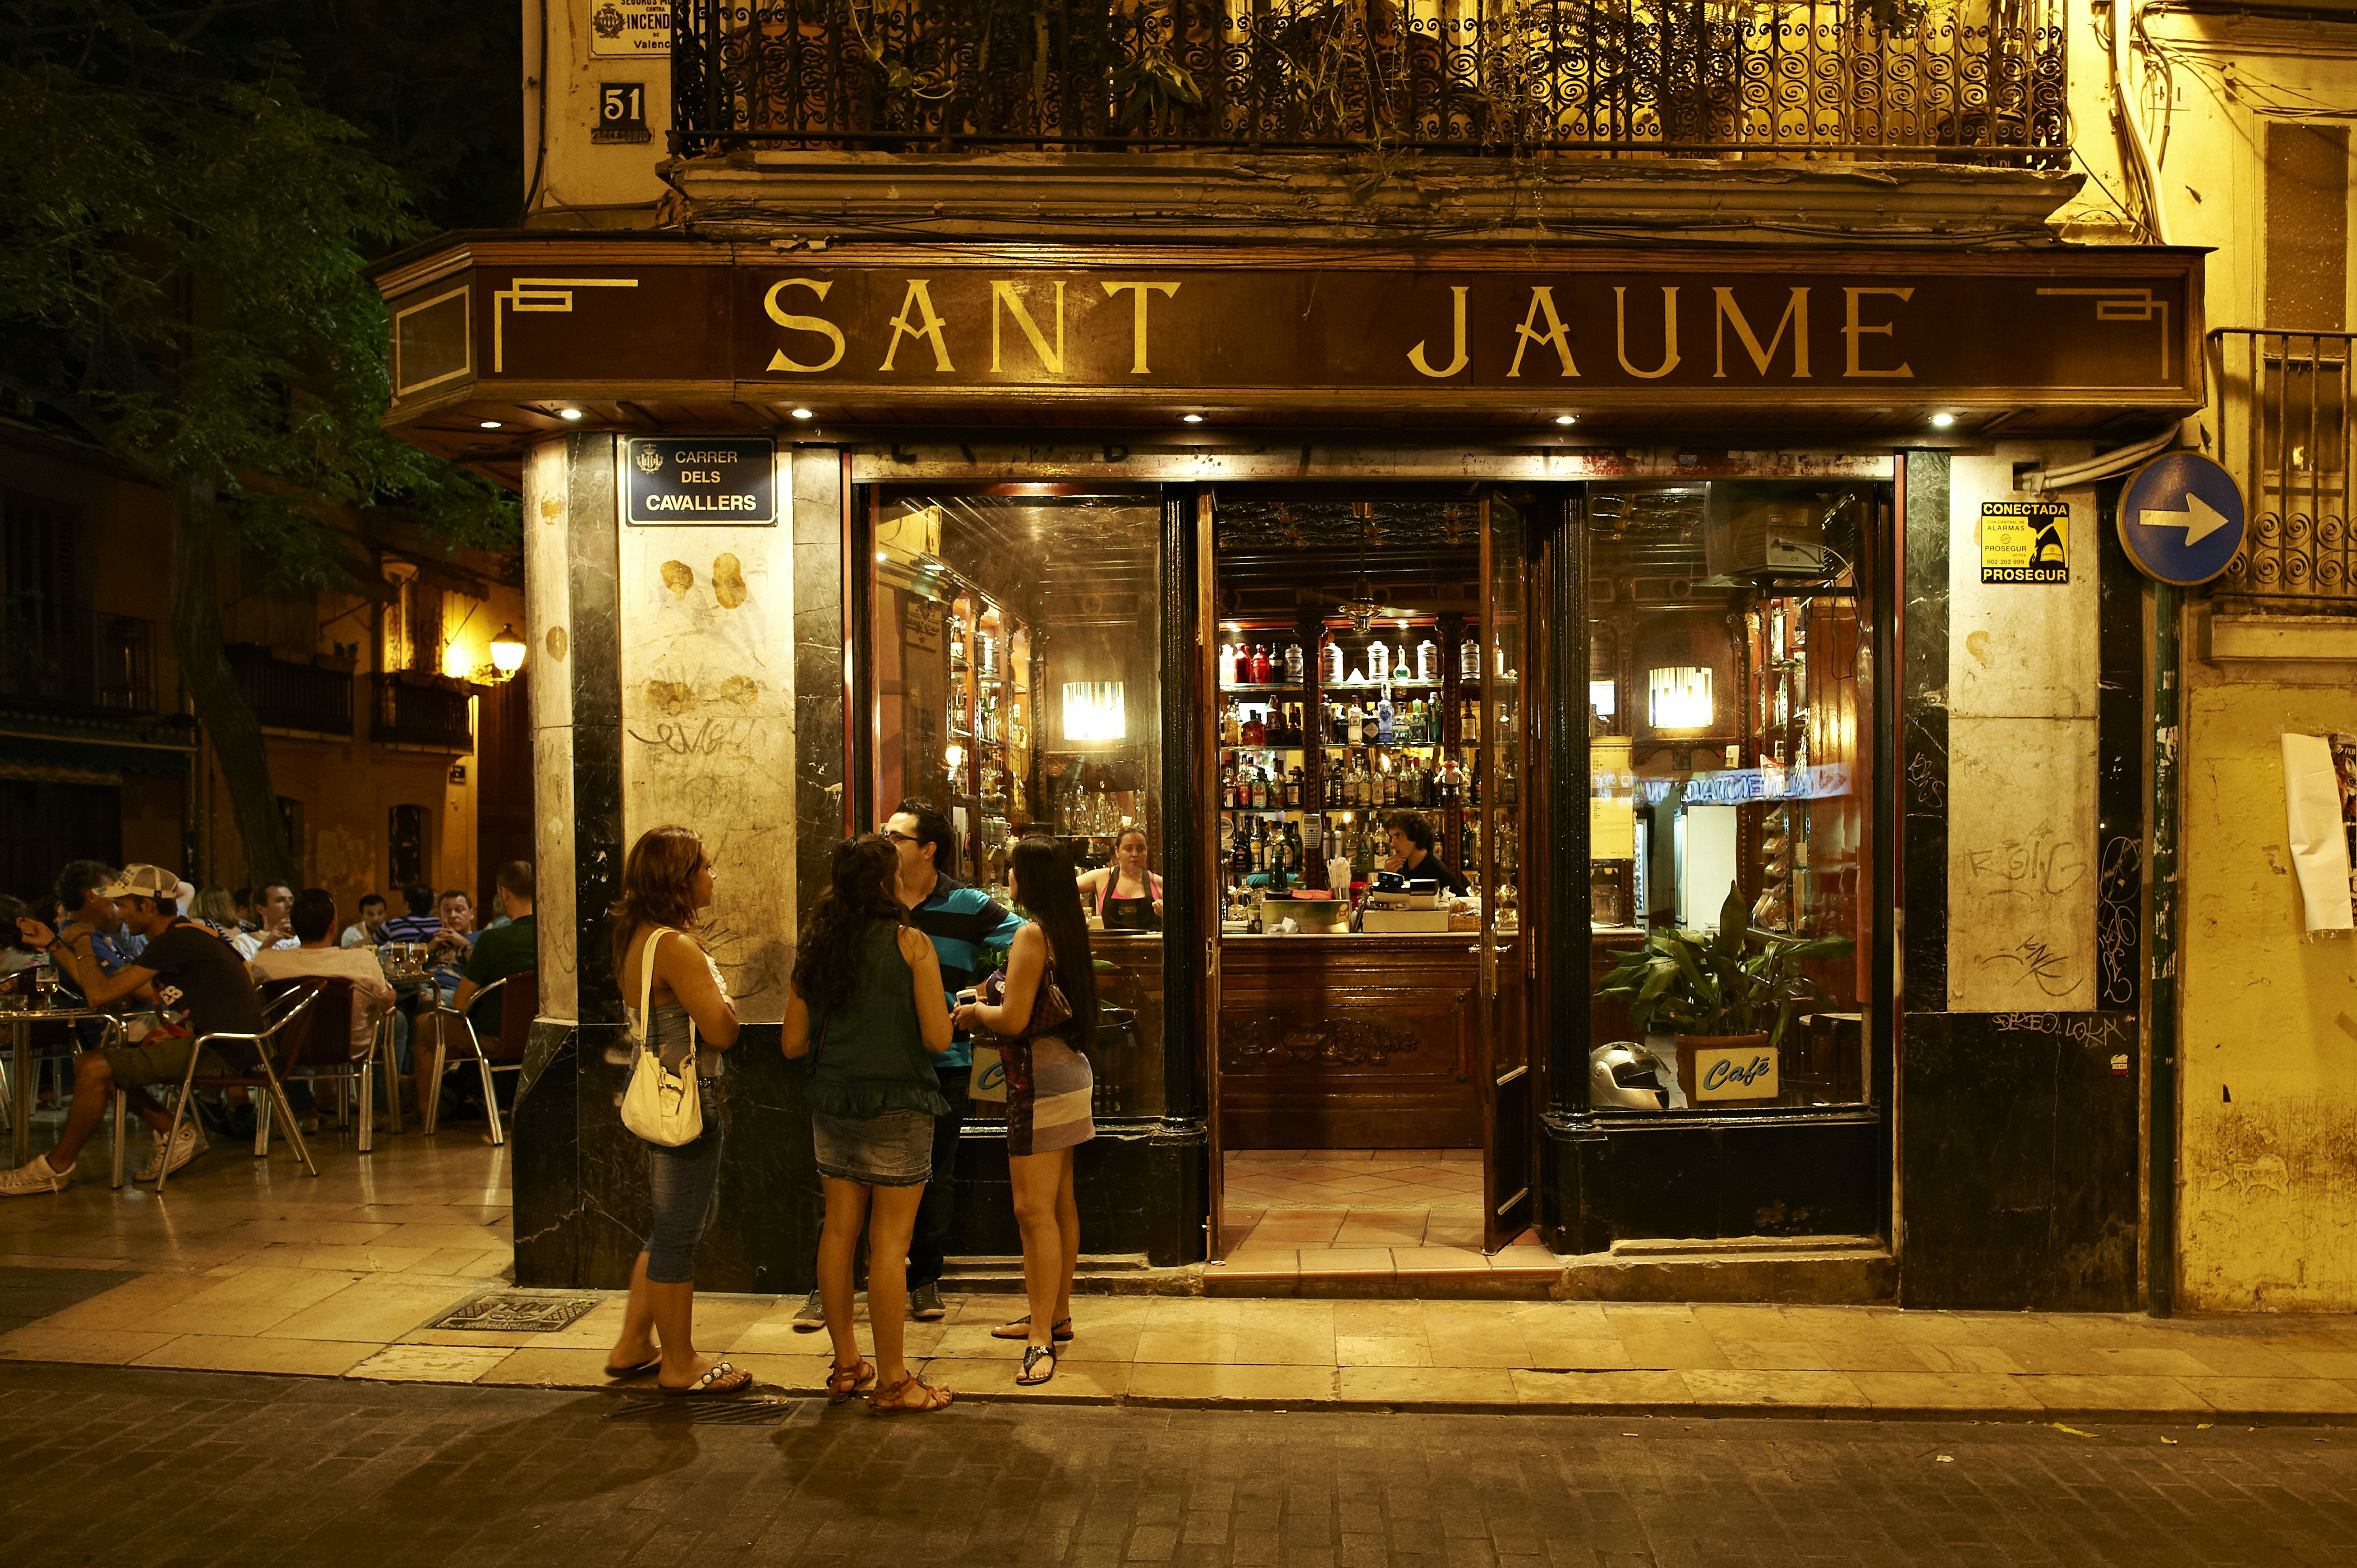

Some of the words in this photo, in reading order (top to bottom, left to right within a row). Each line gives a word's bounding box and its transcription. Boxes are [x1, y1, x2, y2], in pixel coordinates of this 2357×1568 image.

[627, 14, 671, 29] INCEND
[634, 40, 671, 49] Valenc
[604, 88, 640, 120] 51
[764, 278, 1182, 374] SANT
[1407, 286, 1916, 378] JAUME
[675, 451, 737, 463] CARRER
[681, 471, 721, 483] DELS
[646, 494, 756, 511] CAVALLERS
[1983, 503, 2067, 515] CONECTADA
[1983, 569, 2066, 581] PROSEGUR
[1703, 1056, 1771, 1091] Café
